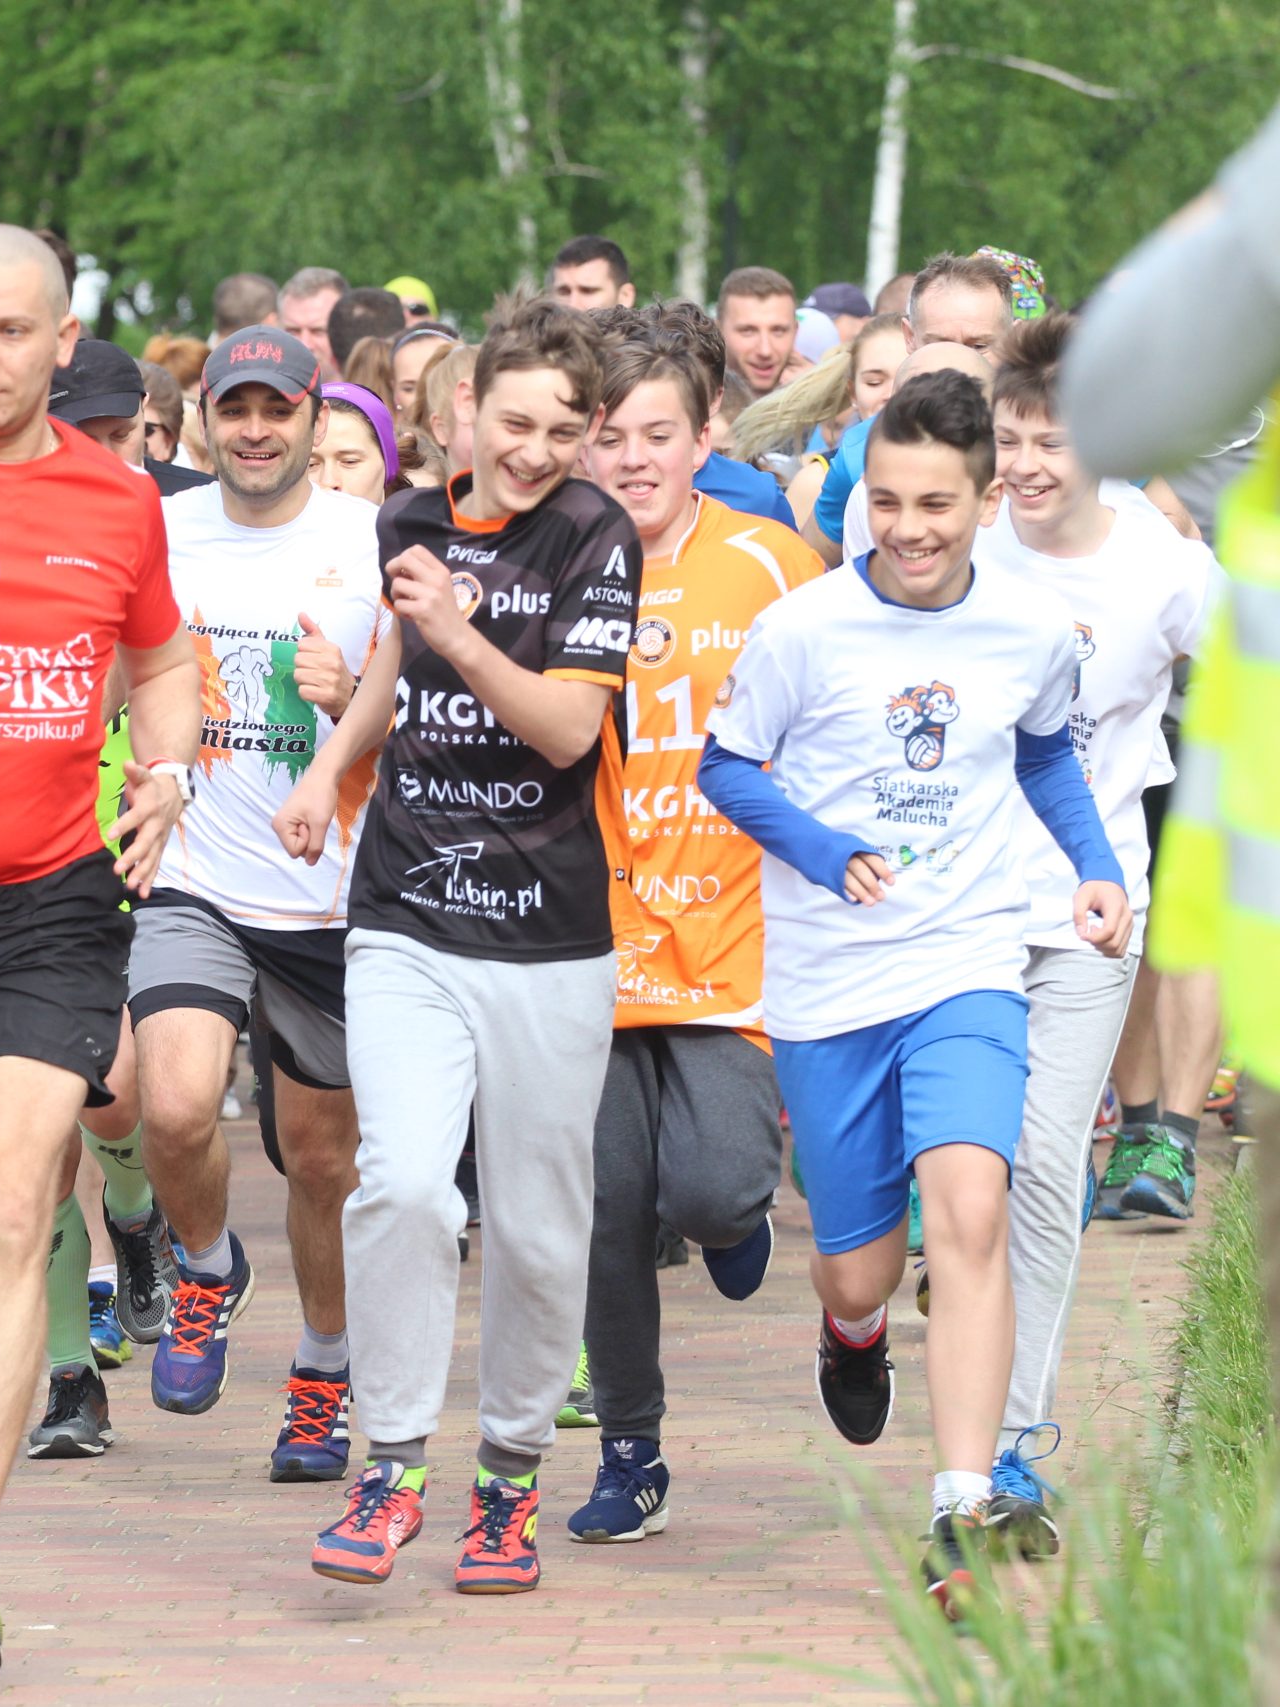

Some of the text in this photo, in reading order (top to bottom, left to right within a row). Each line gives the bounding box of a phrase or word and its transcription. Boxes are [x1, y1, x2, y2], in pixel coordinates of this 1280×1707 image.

[491, 585, 552, 619] plus
[264, 629, 307, 643] Kas
[420, 731, 528, 746] POLSKA MI
[428, 776, 543, 809] MUNDO
[872, 776, 959, 796] Siatkarska
[874, 792, 954, 811] Akademia
[877, 808, 948, 827] Malucha
[400, 891, 440, 909] miasto
[445, 875, 542, 917] lubin.pl
